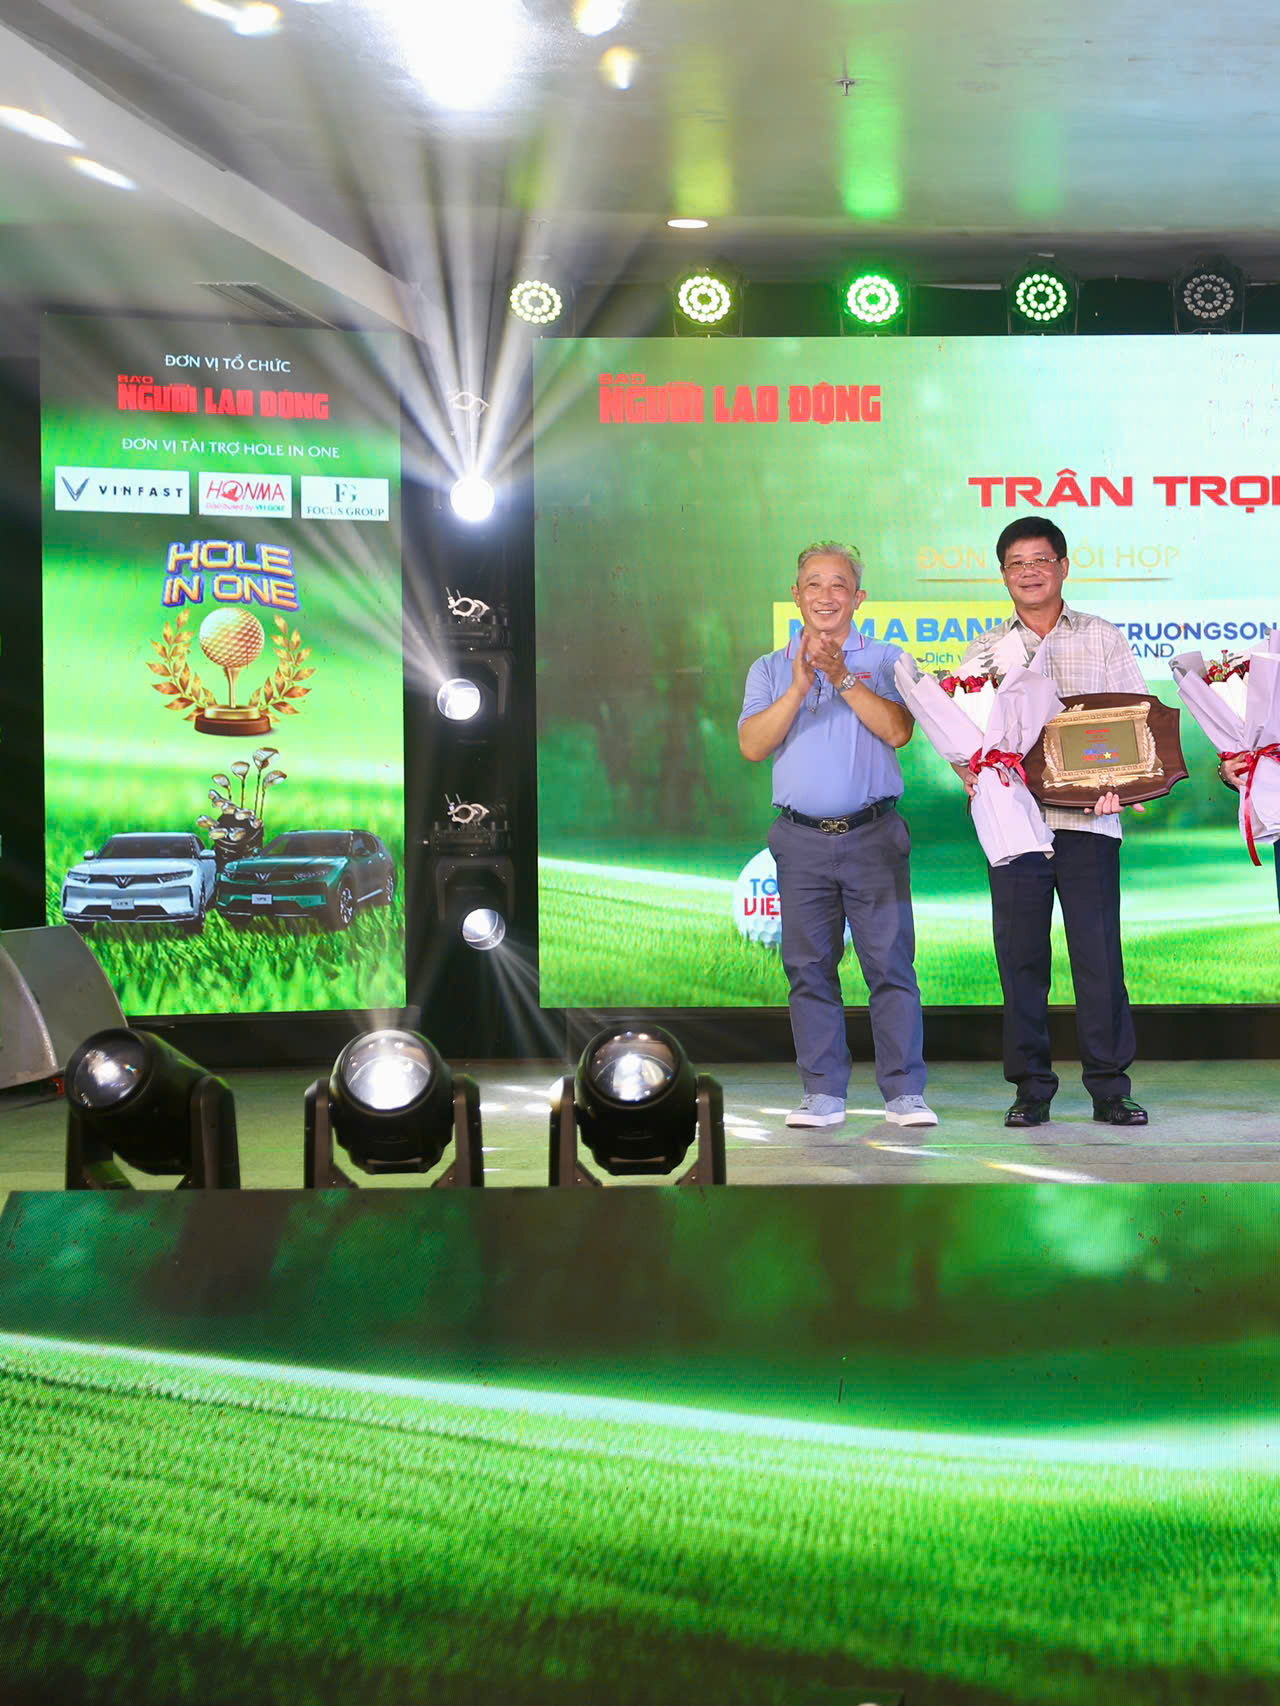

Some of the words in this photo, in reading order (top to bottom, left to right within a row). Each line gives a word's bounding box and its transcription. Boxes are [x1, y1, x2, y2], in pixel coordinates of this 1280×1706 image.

[165, 354, 200, 368] ĐƠN
[205, 357, 219, 371] VỊ
[247, 358, 291, 373] CHỨC
[205, 387, 254, 416] LAO
[713, 384, 779, 423] LAO
[122, 437, 158, 450] ĐƠN
[163, 440, 176, 454] VỊ
[181, 438, 205, 453] TÀI
[209, 441, 240, 456] TRỢ
[244, 444, 284, 457] HOLE
[288, 445, 304, 457] IN
[308, 445, 340, 458] ONE
[98, 485, 183, 498] VINFAST
[206, 480, 285, 502] HONMA
[968, 468, 1133, 507] TRÂN
[306, 506, 344, 515] FOCUS
[346, 507, 384, 517] GROUP
[166, 540, 295, 579] HOLE
[919, 544, 985, 569] ĐƠN
[1116, 544, 1178, 574] HỢP
[162, 574, 201, 609] IN
[212, 574, 300, 612] ONE
[884, 618, 909, 641] A
[916, 618, 1002, 641] BAN
[925, 652, 954, 665] Dịch
[1131, 643, 1175, 658] AND
[750, 874, 778, 896] TÔ
[744, 893, 781, 920] VIỆ
